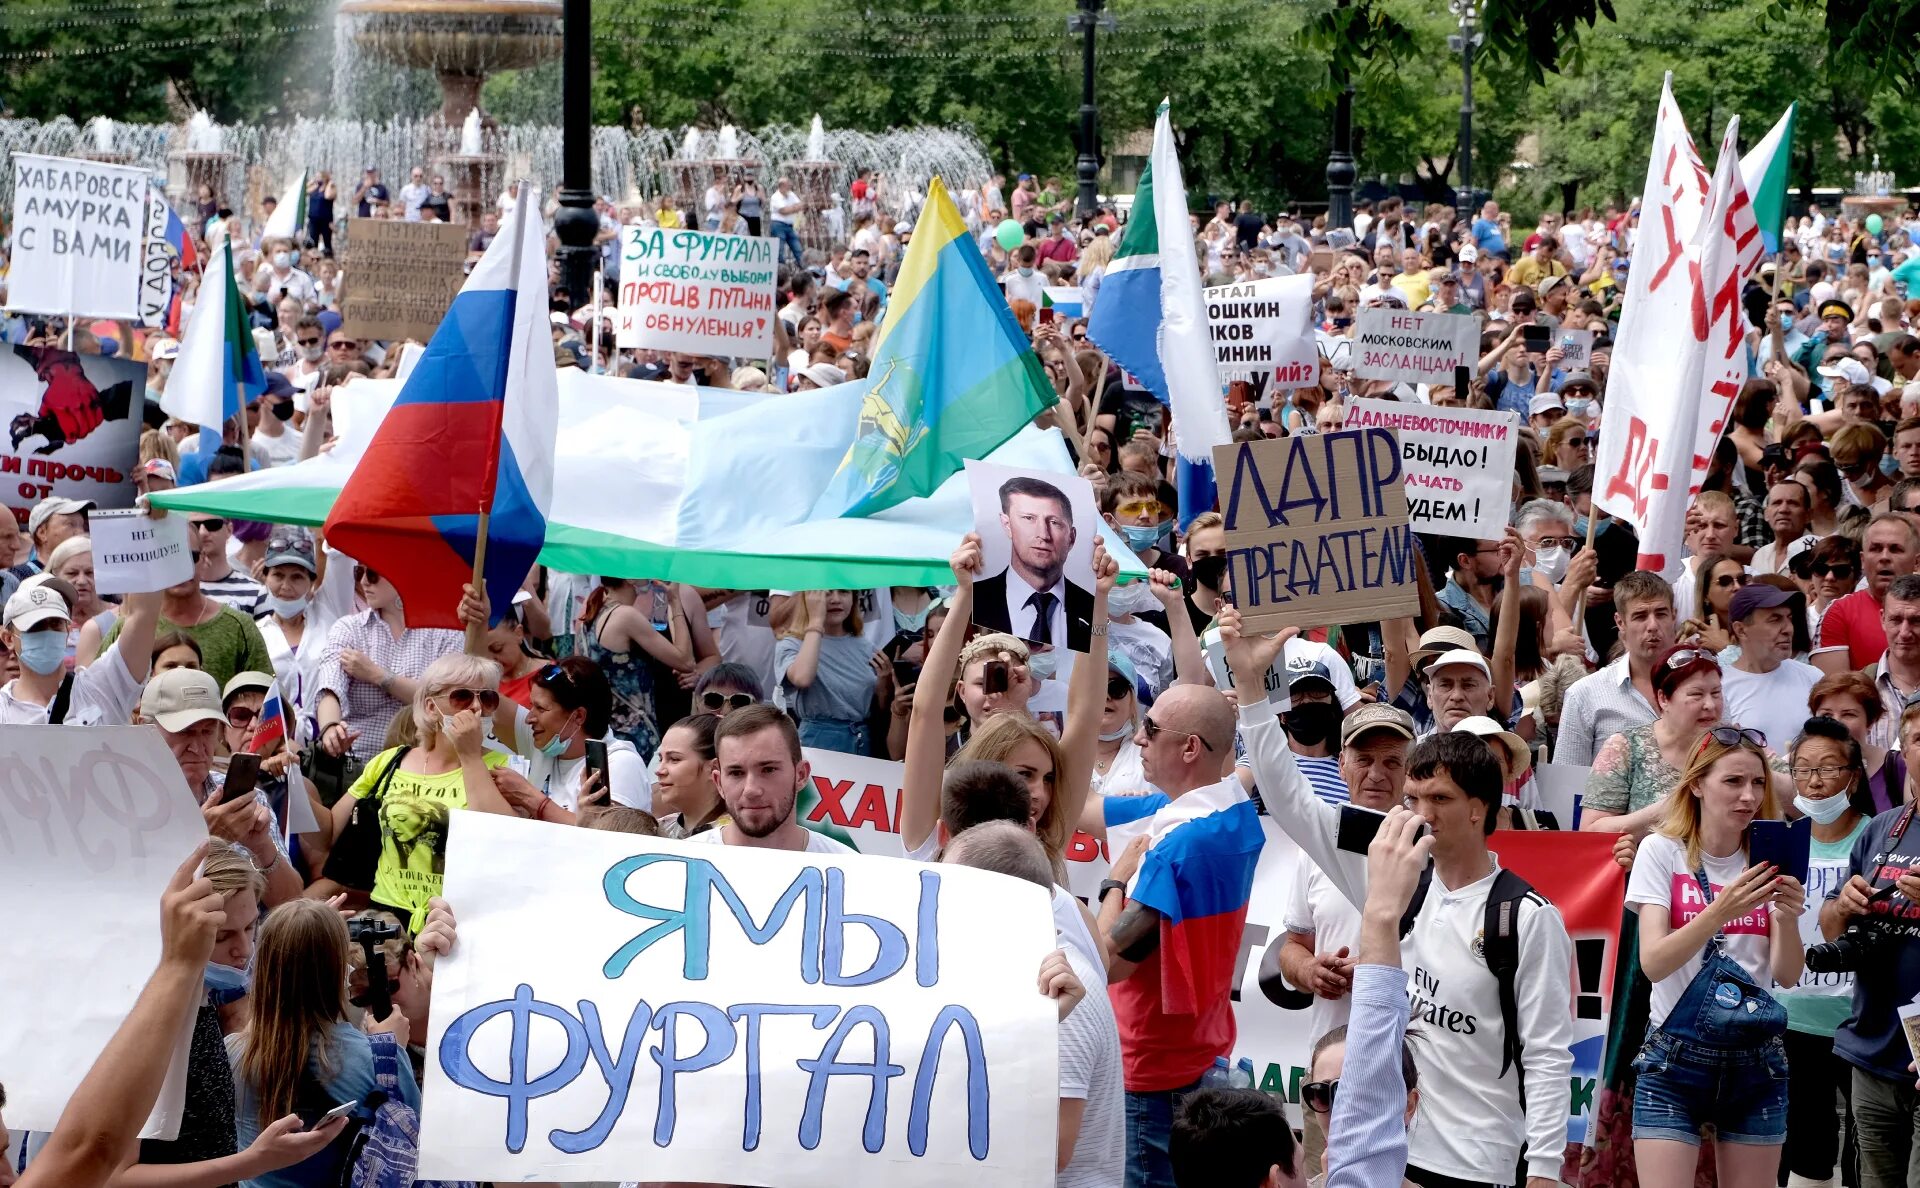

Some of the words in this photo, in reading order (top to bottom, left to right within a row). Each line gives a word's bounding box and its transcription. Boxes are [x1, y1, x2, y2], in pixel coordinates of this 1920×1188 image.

[18, 166, 139, 203] ХАБАРОВСК
[25, 197, 131, 229] АМУРКА
[19, 227, 36, 250] С
[53, 228, 131, 263] ВАМИ
[625, 228, 664, 261] ЗА
[673, 232, 771, 264] ФУРГАЛА
[638, 264, 651, 278] И
[653, 263, 719, 281] СВОБОДУ
[623, 281, 701, 310] ПРОТИВ
[709, 287, 772, 312] ПУТИНА
[1207, 302, 1280, 319] ОШКИН
[622, 317, 632, 330] И
[645, 315, 767, 340] ОБНУЛЕНИЯ!
[1391, 317, 1424, 331] НЕТ
[1216, 345, 1272, 363] ИНИН
[1361, 333, 1453, 351] МОСКОВСКИМ
[1362, 351, 1465, 374] ЗАСЛАНЦАМ!
[1344, 405, 1508, 441] ДАЛЬНЕВОСТОЧНИКИ
[1403, 443, 1487, 468] БЫДЛО!
[27, 459, 124, 483] прочь
[1224, 428, 1402, 531] ЛДПР
[1405, 473, 1464, 492] ЛЧАТЬ
[18, 482, 53, 499] от
[1407, 497, 1480, 524] УДЕМ!
[131, 528, 156, 541] НЕТ
[104, 544, 180, 565] ГЕНОЦИДУ!!!
[1226, 523, 1418, 610] ПРЕДАТЕЛИ
[1757, 914, 1766, 928] is
[1415, 967, 1440, 997] Fly
[1407, 988, 1477, 1035] irates
[438, 983, 991, 1161] ФУРГАЛ
